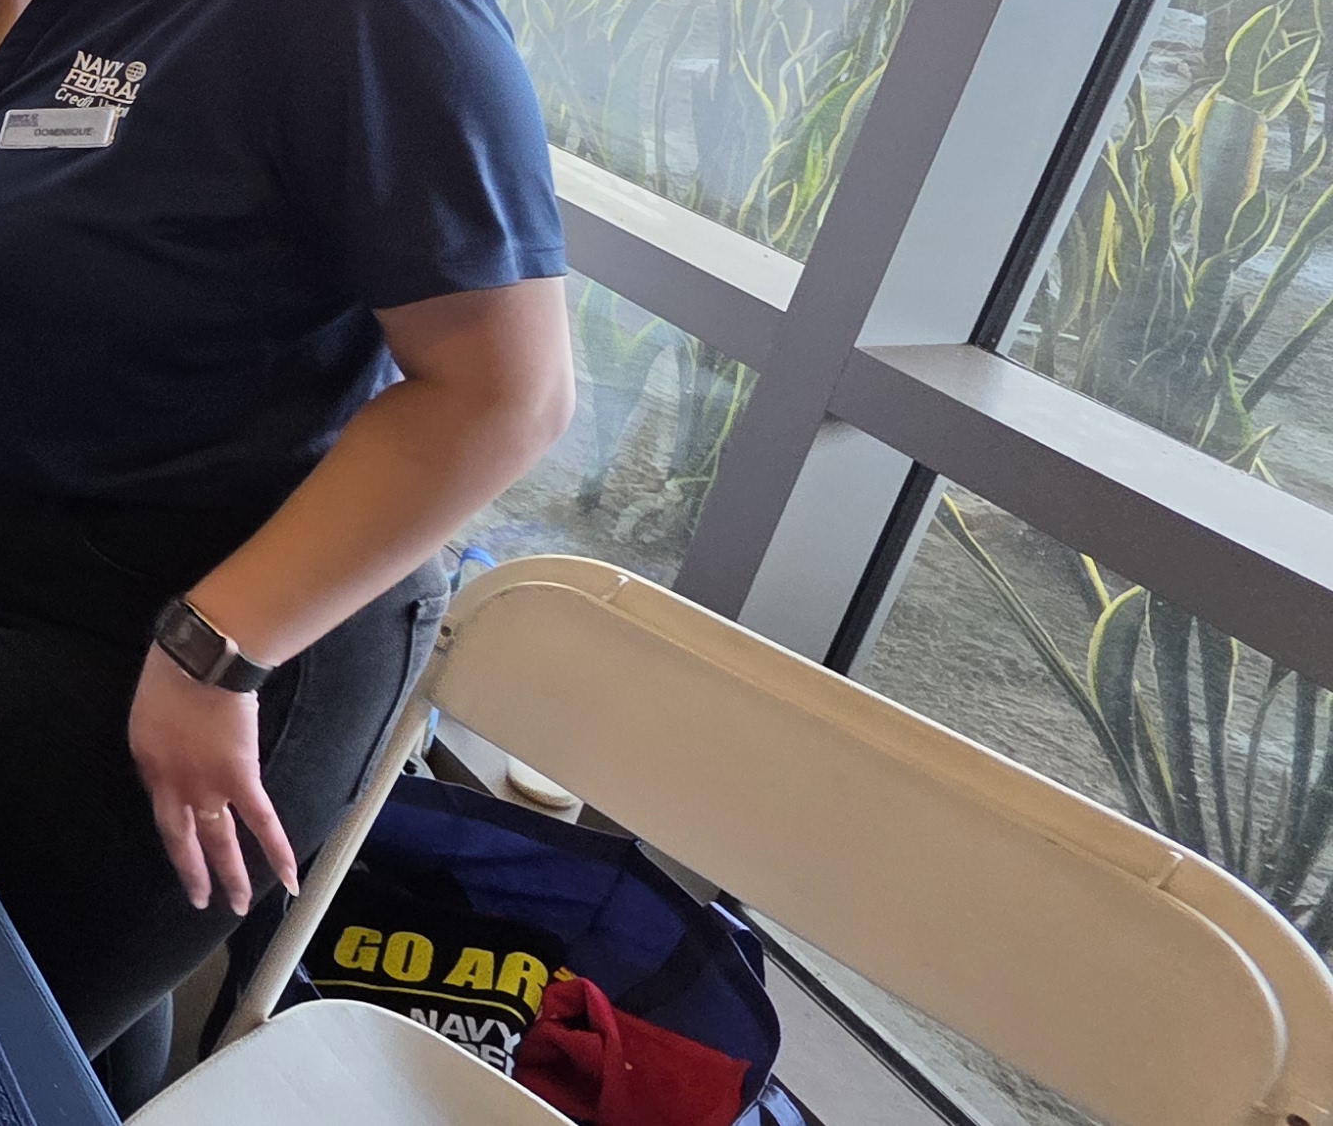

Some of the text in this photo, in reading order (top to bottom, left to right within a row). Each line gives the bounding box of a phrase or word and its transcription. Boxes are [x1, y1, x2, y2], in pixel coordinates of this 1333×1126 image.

[72, 50, 125, 78] NAVY
[54, 86, 94, 108] Credit
[63, 68, 141, 100] FEDERAL
[333, 925, 576, 1016] GO AR
[409, 1007, 521, 1055] NAVY
